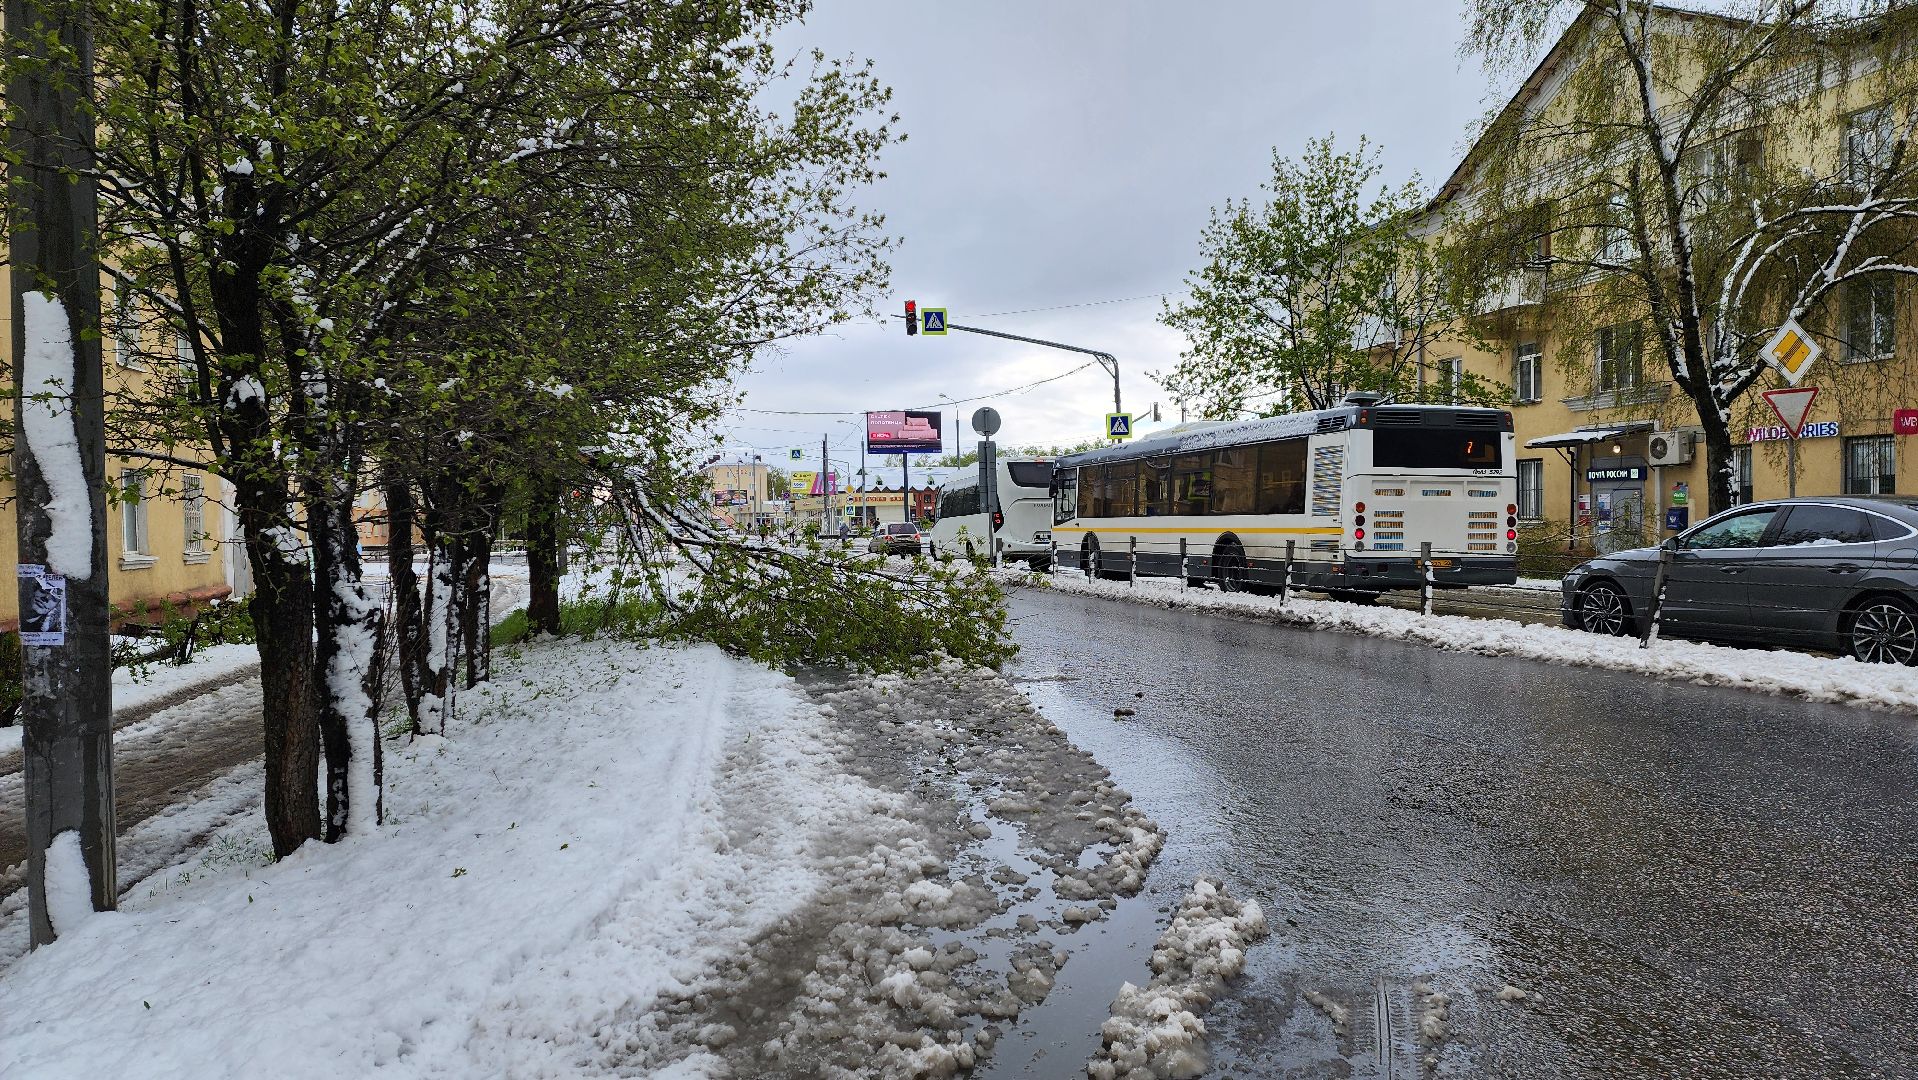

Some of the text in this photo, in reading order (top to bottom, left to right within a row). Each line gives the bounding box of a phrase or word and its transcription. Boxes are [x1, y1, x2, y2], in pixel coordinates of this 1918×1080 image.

[1747, 422, 1838, 441] WILDBRRIES
[1467, 441, 1473, 454] 7
[1588, 470, 1628, 480] ПОЧТА РОССИИ
